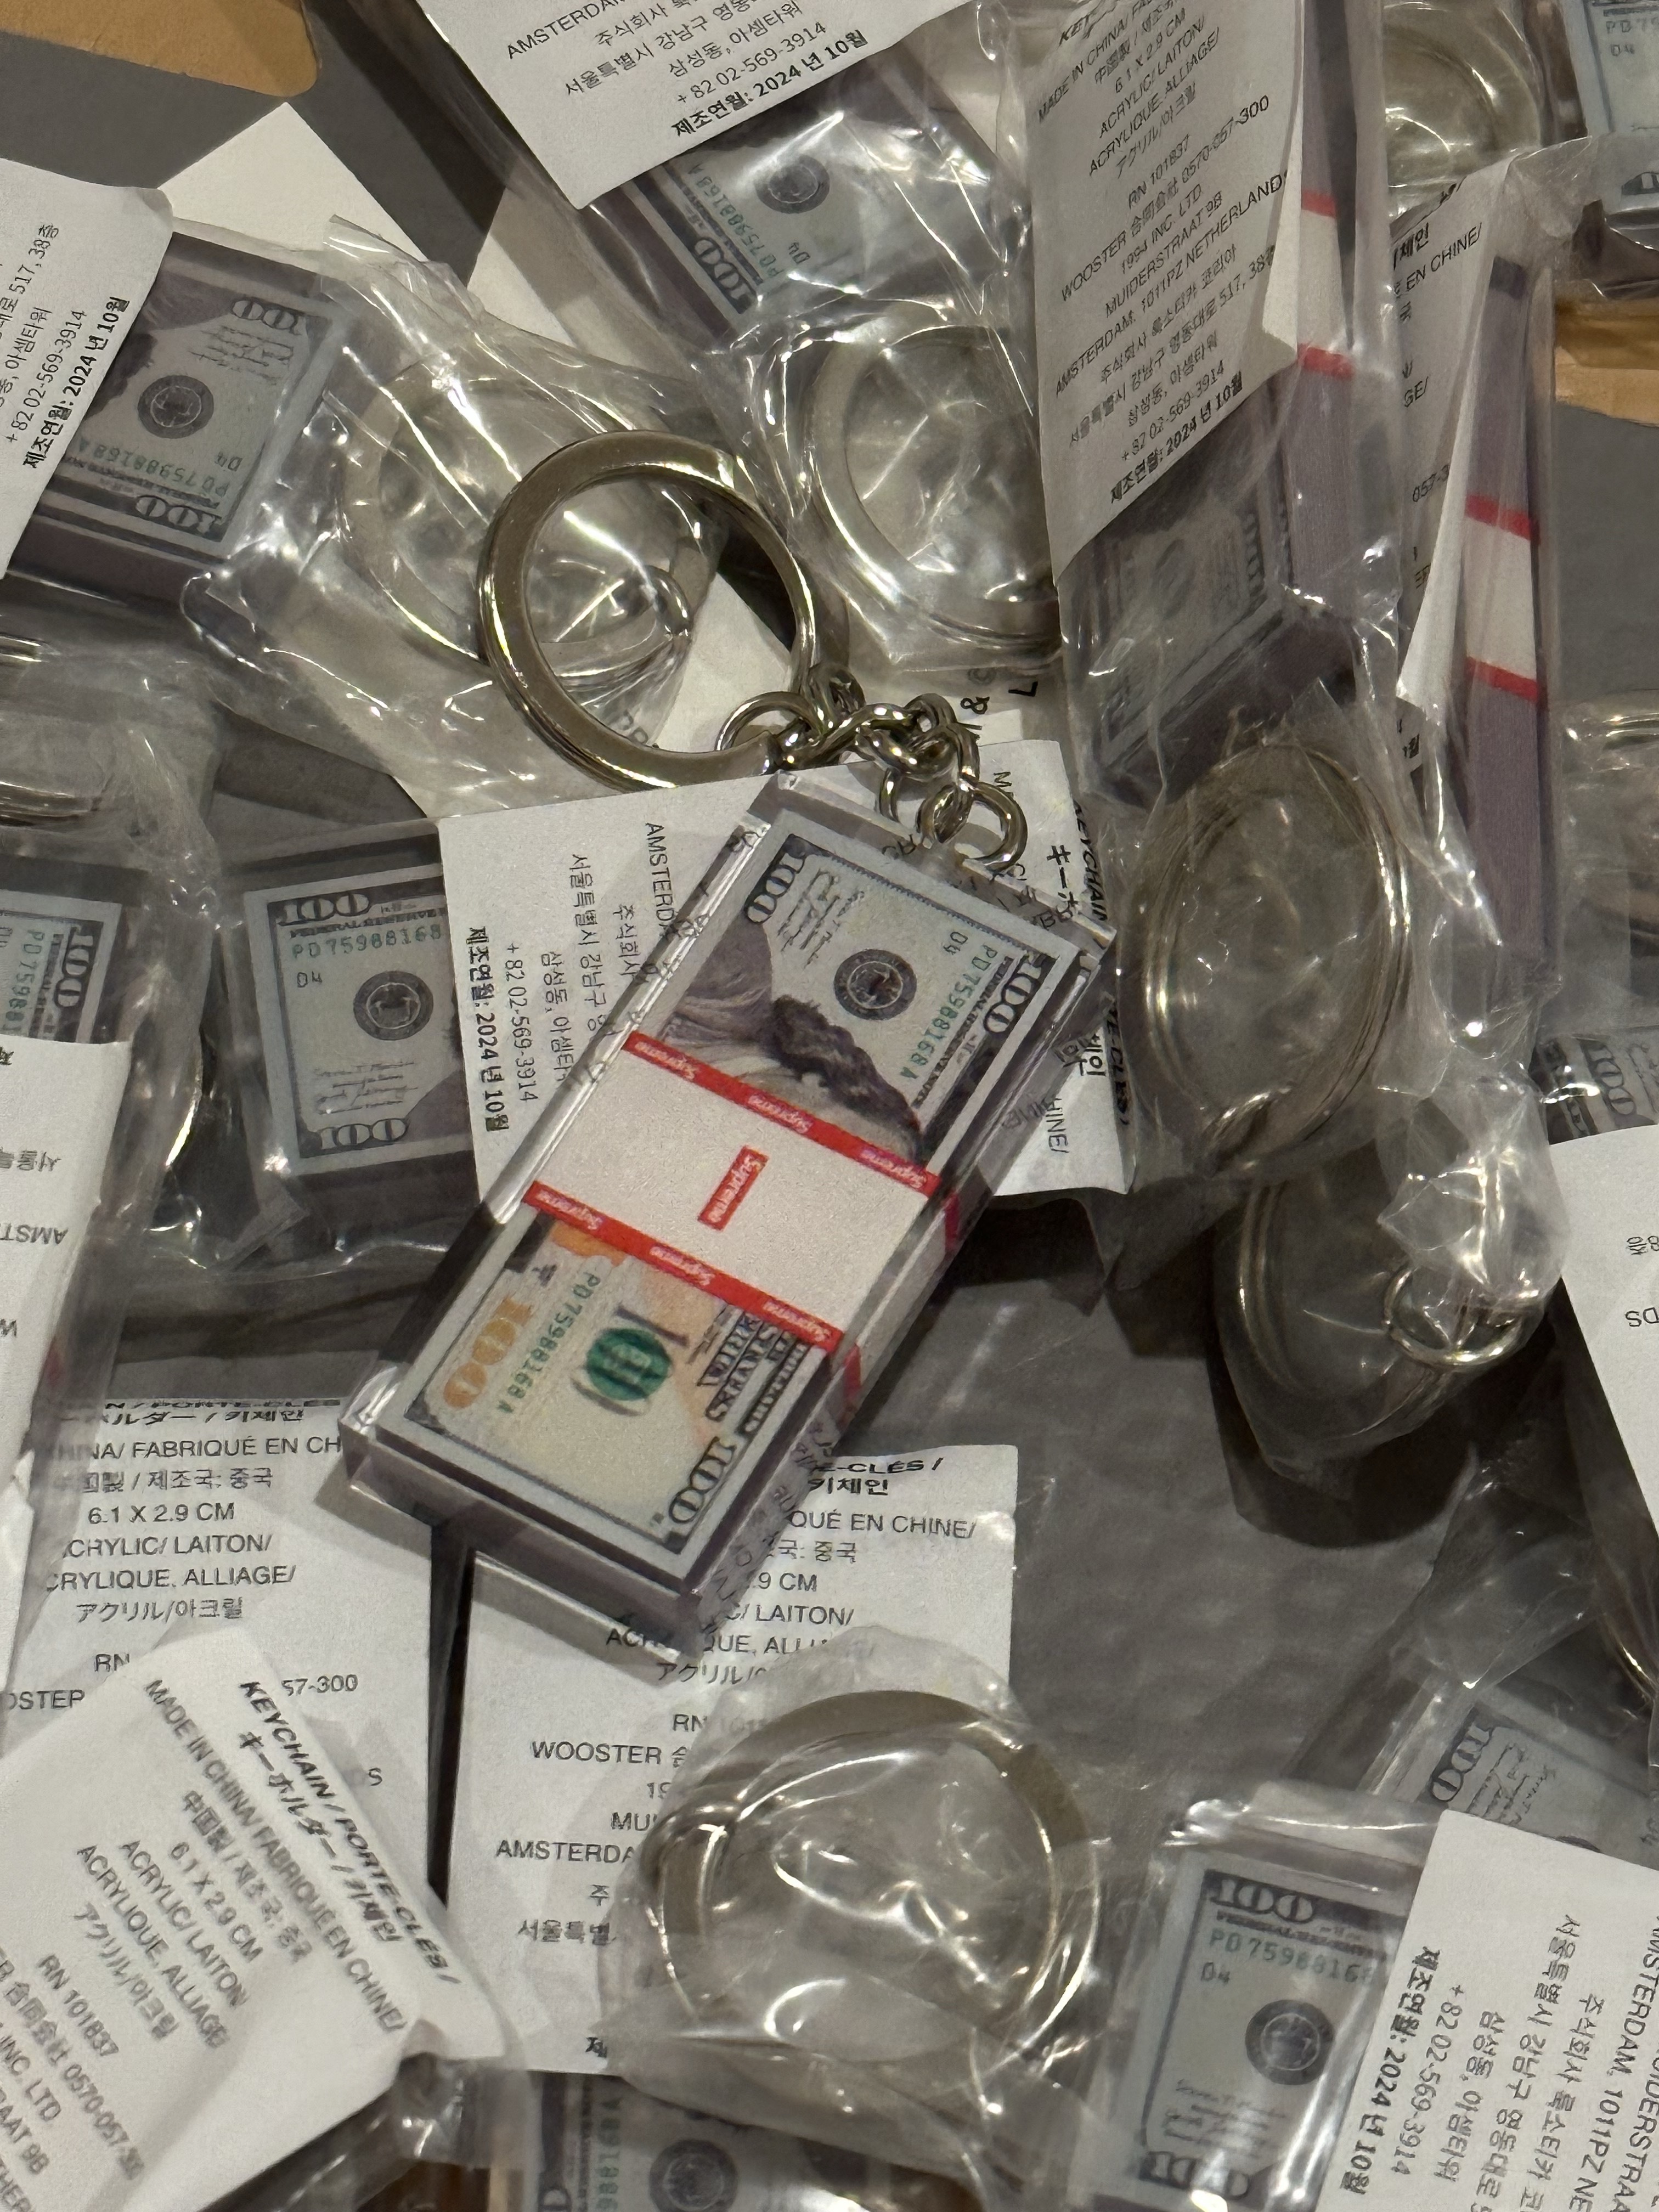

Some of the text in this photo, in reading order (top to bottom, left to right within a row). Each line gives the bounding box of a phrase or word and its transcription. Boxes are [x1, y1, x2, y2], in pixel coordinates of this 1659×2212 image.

[507, 0, 625, 60] AMSTERDA
[595, 3, 668, 47] 주식회사
[655, 15, 708, 50] 강남구
[671, 29, 868, 137] 제조연월: 2024 년 10월
[690, 21, 826, 99] 82 02-569-3914
[1061, 232, 1126, 302] WOOSTER
[22, 311, 87, 408] 02-569-3914
[62, 356, 97, 397] 2024
[10, 410, 35, 431] 82
[280, 891, 370, 924] 100
[742, 847, 807, 930] 100
[579, 953, 607, 1008] 강남구
[978, 954, 1047, 1040] 100
[475, 1013, 499, 1060] 2024
[505, 959, 539, 1102] 82 02-569-3914
[132, 1435, 298, 1458] FABRIQUÉ EN
[229, 1467, 273, 1489] 중국
[663, 1432, 740, 1531] 100
[129, 1505, 146, 1523] X
[153, 1504, 189, 1522] 2.9
[196, 1502, 234, 1521] CM
[850, 1513, 883, 1532] EN
[891, 1515, 976, 1539] CHINE/
[59, 1534, 272, 1559] CRYLIC/ LAITON/
[814, 1541, 856, 1563] 중국
[183, 1565, 296, 1586] ALLIAGE/
[779, 1572, 817, 1592] CM
[755, 1604, 854, 1626] LAITON/
[145, 1679, 196, 1738] MADE
[187, 1736, 213, 1762] IN
[239, 1681, 335, 1808] KEYCHAIN
[532, 1741, 662, 1765] WOOSTER
[193, 1872, 214, 1894] X
[229, 1924, 263, 1962] CM
[1212, 1877, 1317, 1924] 100
[37, 1954, 70, 1991] RN
[1556, 1993, 1605, 2084] 주식회사
[1370, 2047, 1406, 2107] 2024
[1390, 2001, 1463, 2175] 82 02-569-3914
[1505, 2034, 1547, 2101] 강남구
[1581, 2090, 1623, 2174] 1011PZ
